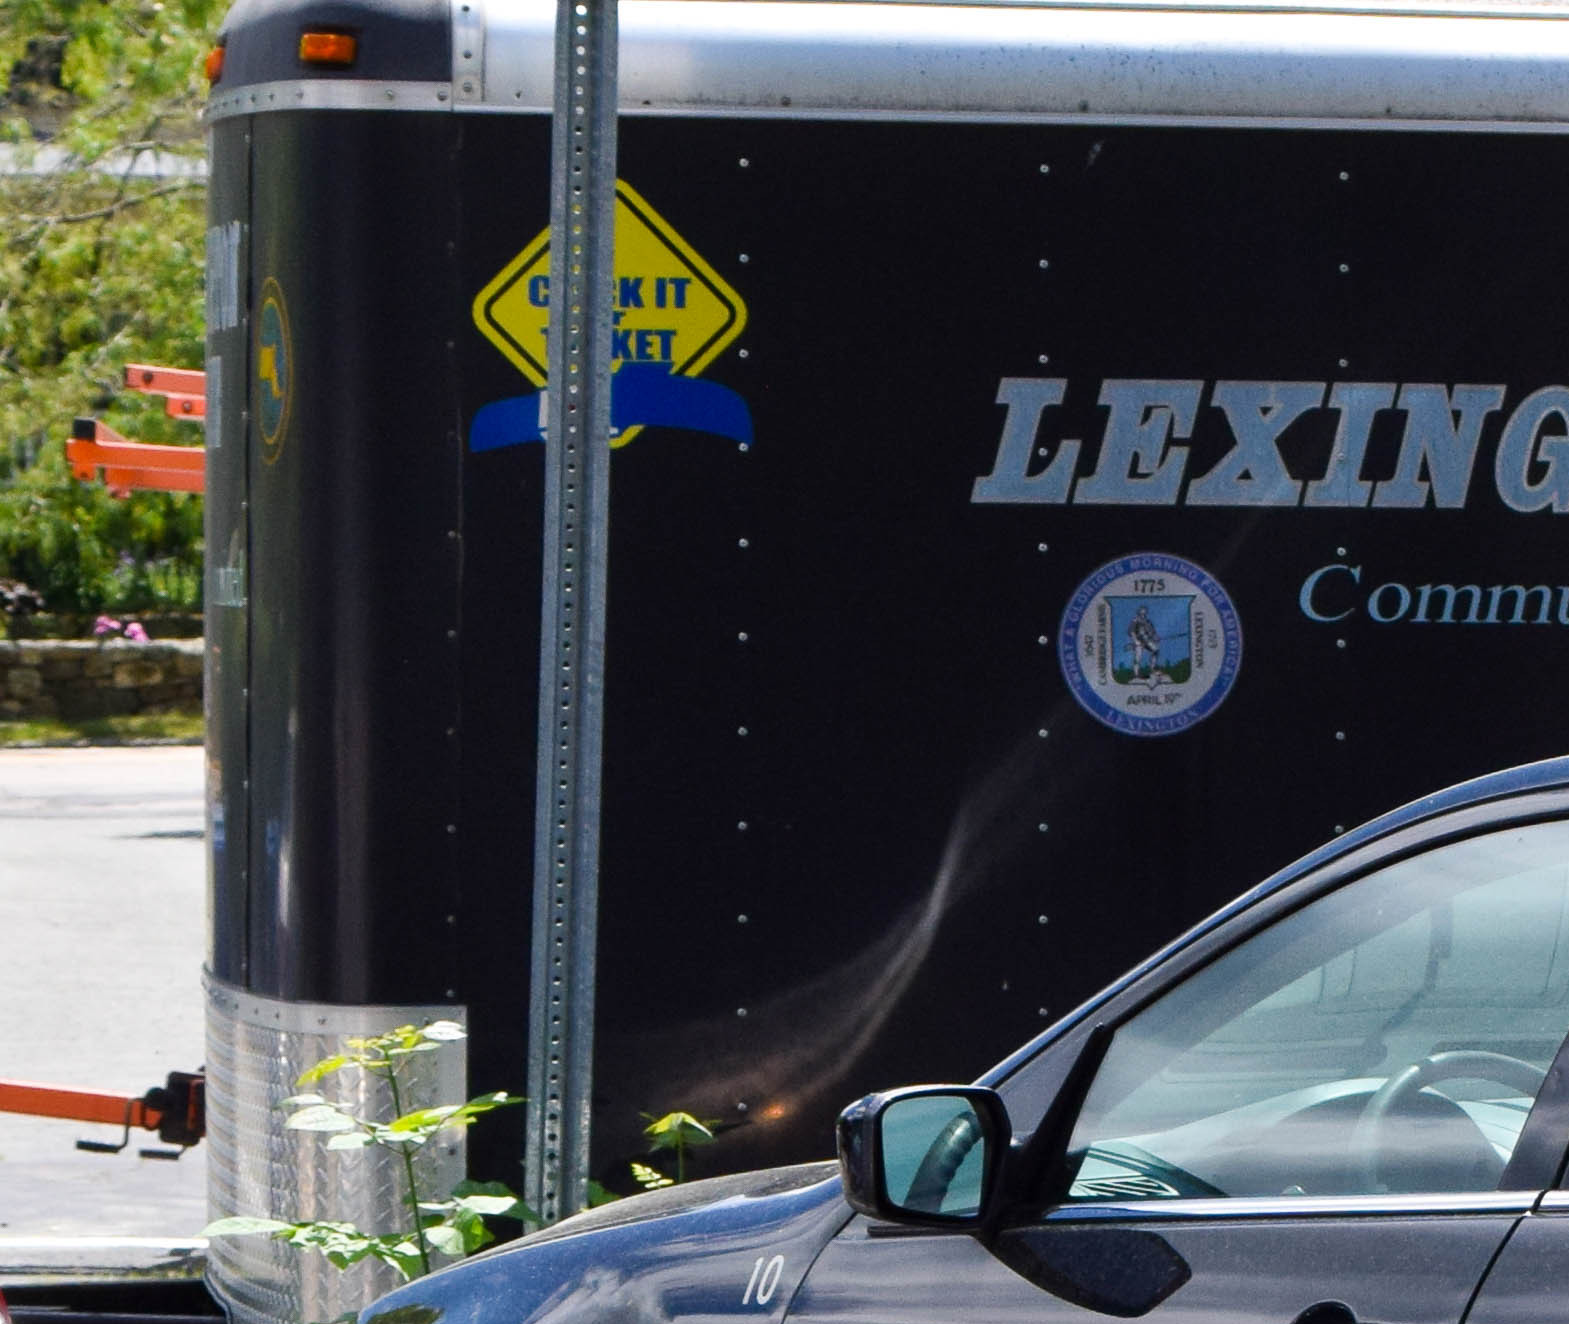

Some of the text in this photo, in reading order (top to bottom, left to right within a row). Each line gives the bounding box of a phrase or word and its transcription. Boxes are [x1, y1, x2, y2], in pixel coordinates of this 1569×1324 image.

[654, 276, 692, 309] IT
[1134, 578, 1166, 593] 1775
[742, 1254, 785, 1305] 10
